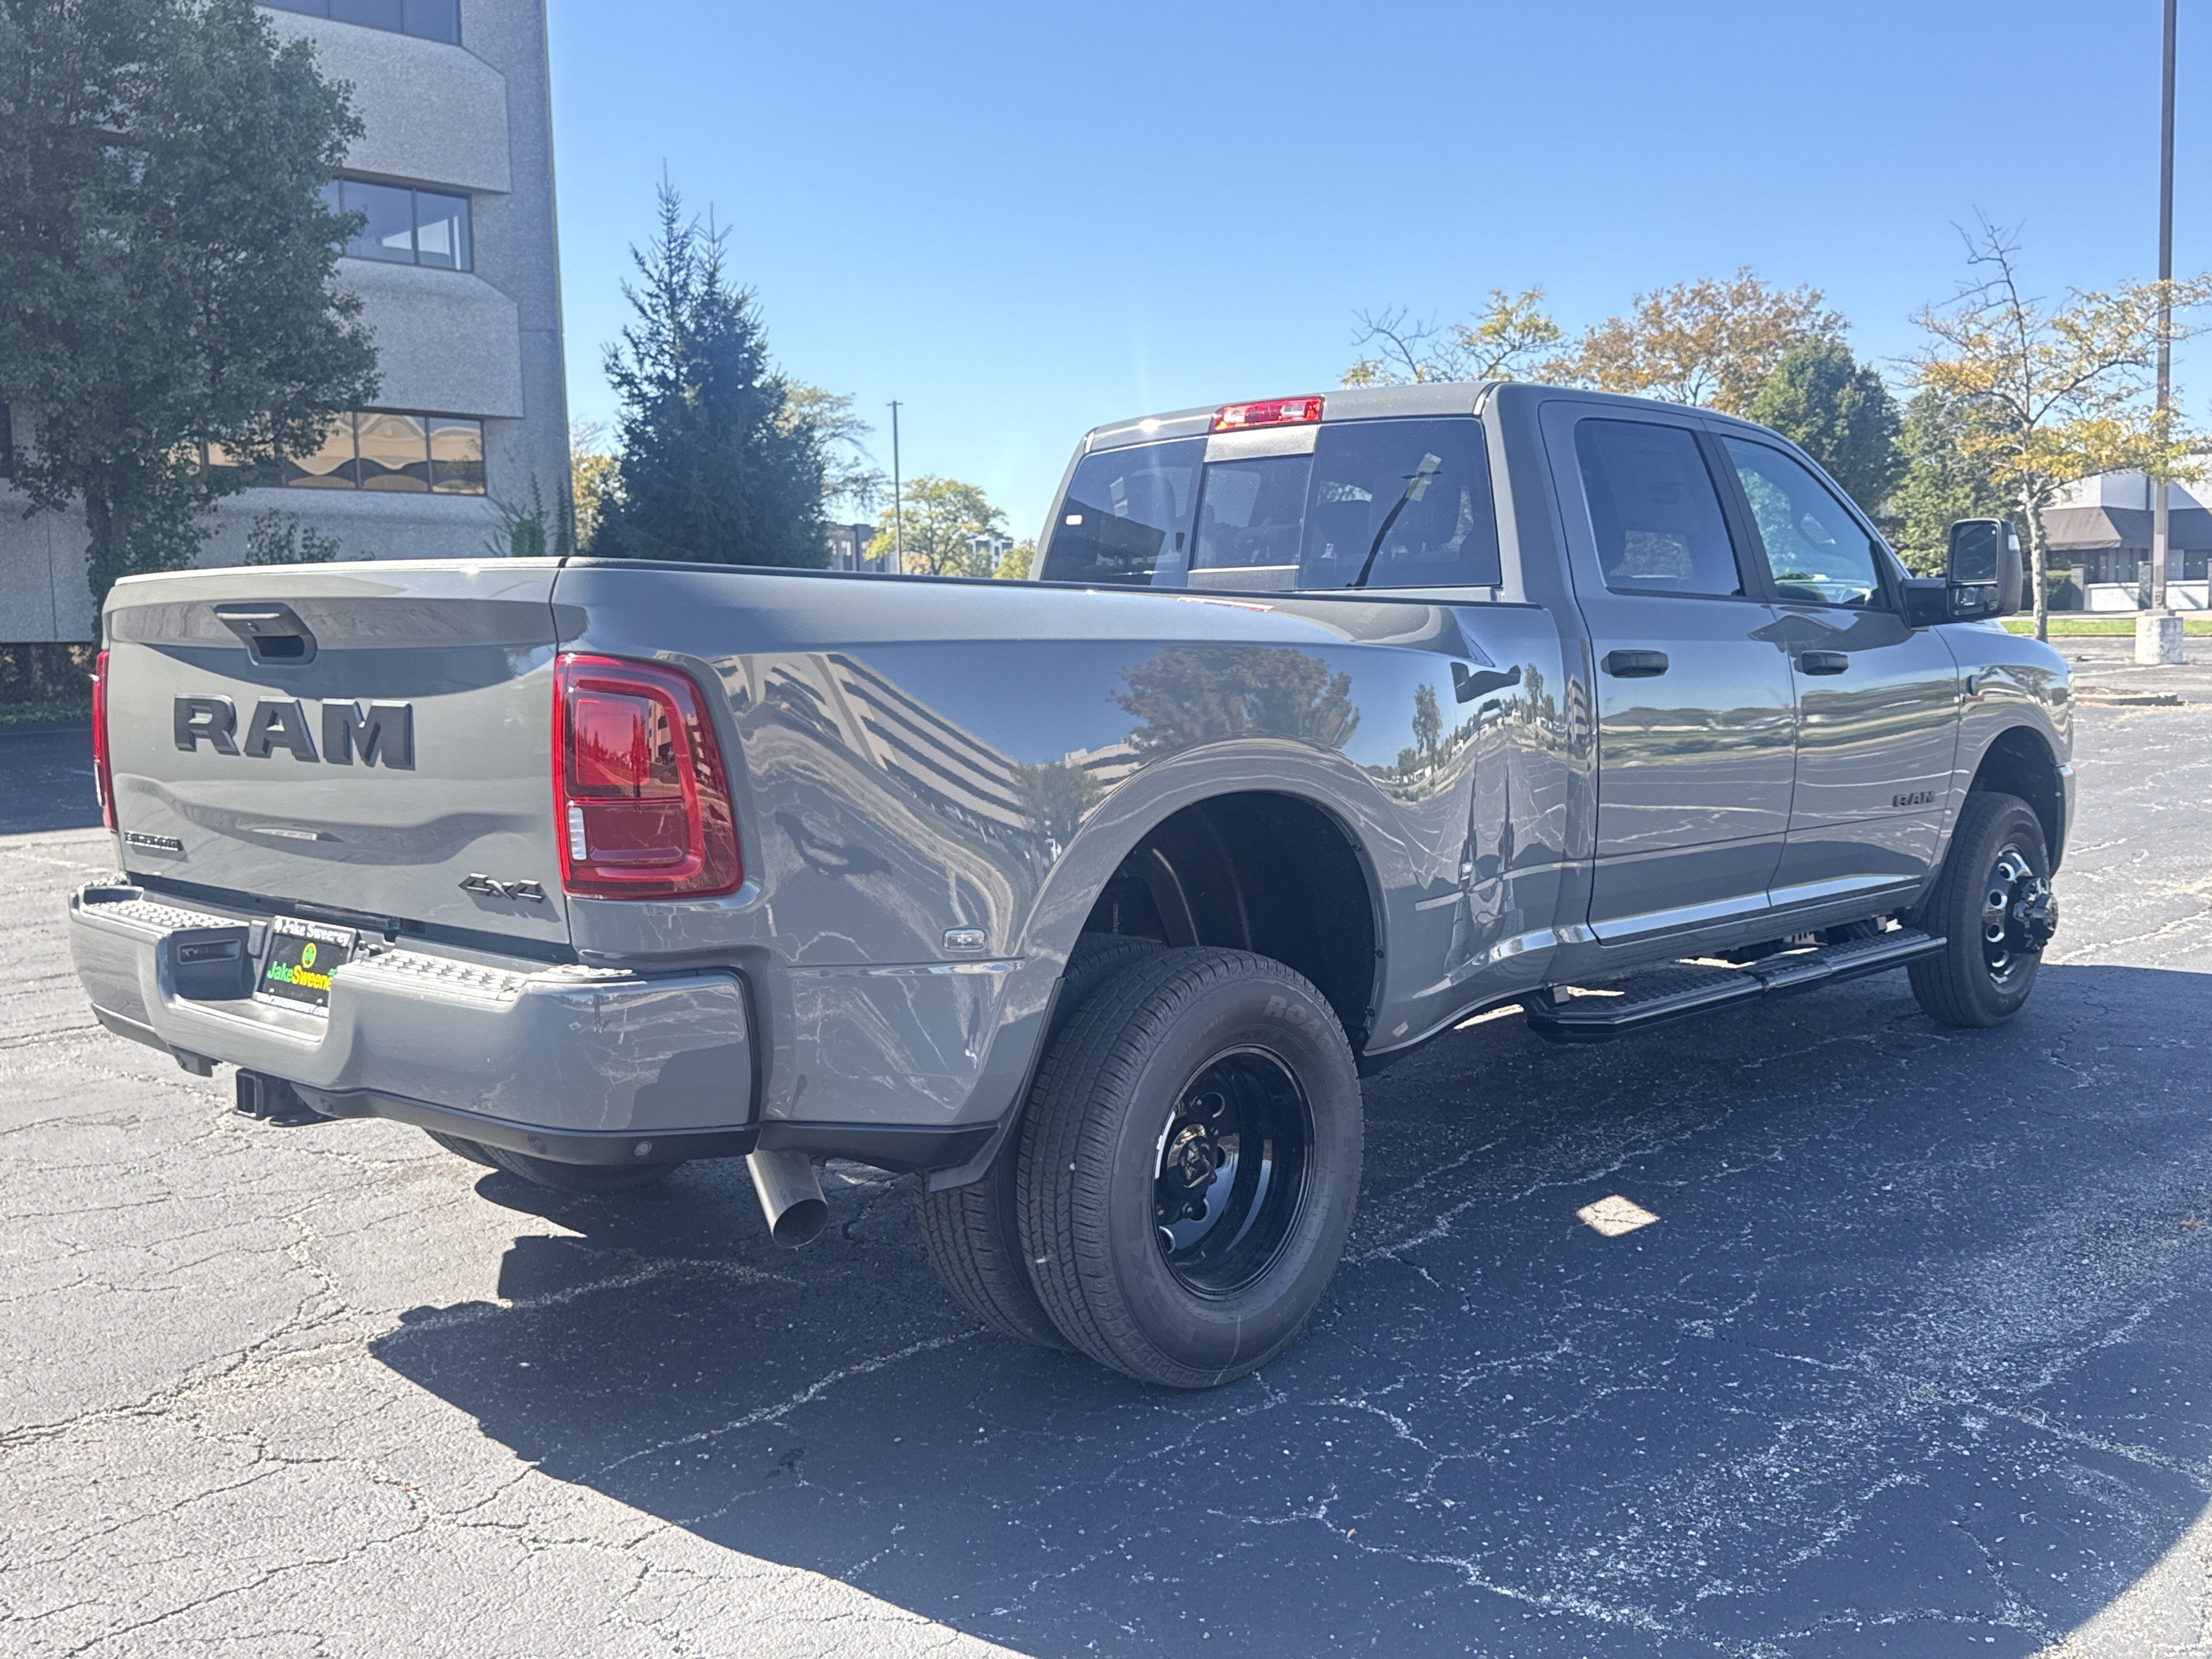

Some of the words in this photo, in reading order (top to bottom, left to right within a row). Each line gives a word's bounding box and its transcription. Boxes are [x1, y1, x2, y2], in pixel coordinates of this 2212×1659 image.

[173, 693, 416, 770] RAM
[1892, 791, 1934, 807] RAM
[267, 961, 332, 991] JakeSweene
